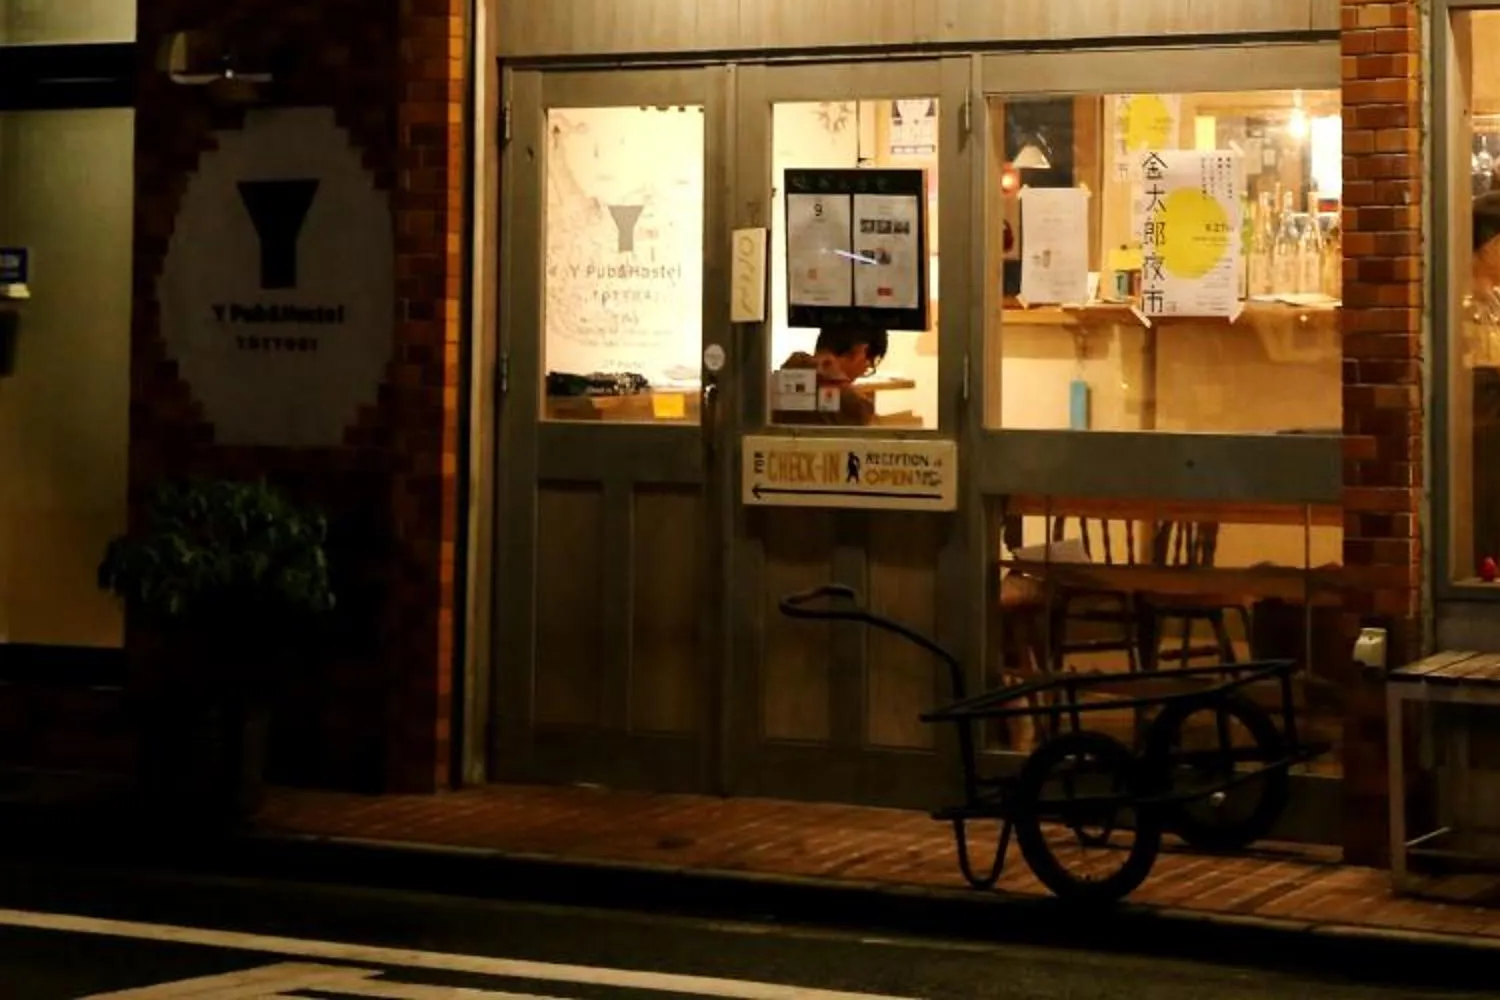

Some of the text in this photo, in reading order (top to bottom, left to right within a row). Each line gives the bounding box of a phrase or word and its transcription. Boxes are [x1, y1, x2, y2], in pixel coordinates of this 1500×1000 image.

[1142, 151, 1168, 312] 金太郎夜市
[211, 303, 227, 322] Y
[768, 451, 841, 483] CHECK-IN
[865, 468, 914, 486] OPEN
